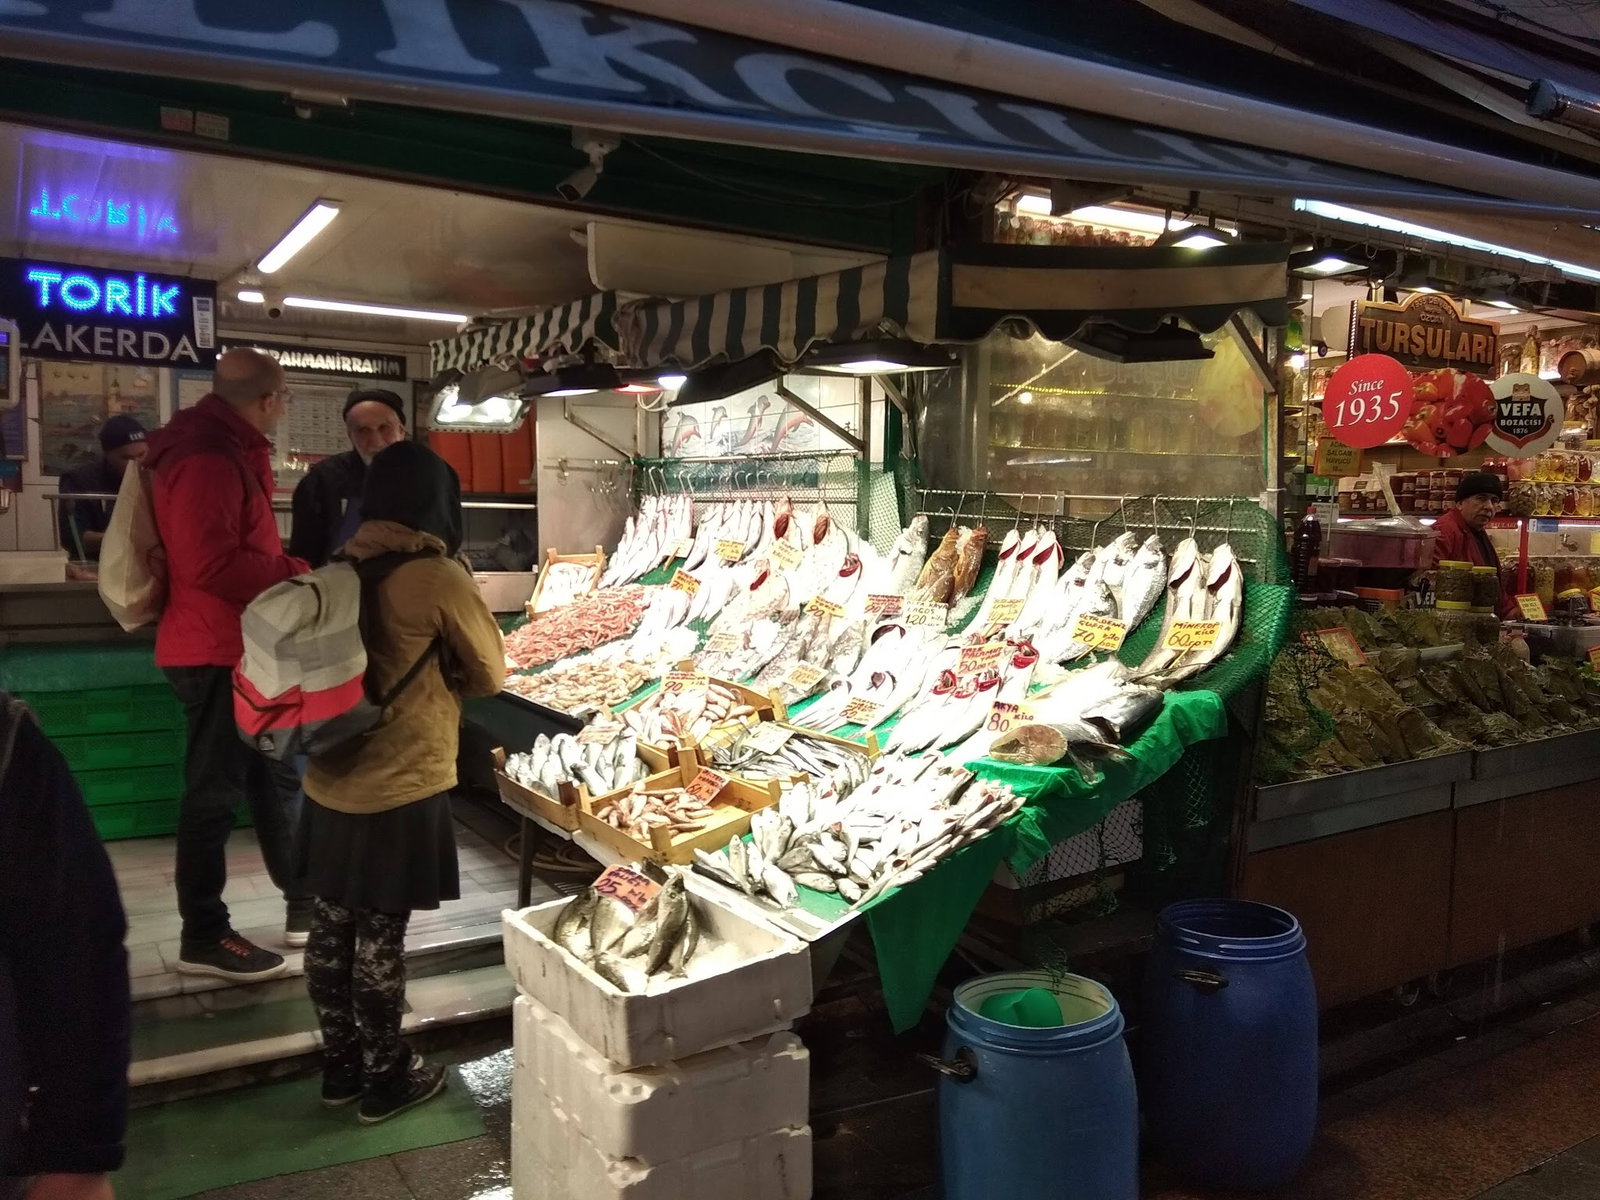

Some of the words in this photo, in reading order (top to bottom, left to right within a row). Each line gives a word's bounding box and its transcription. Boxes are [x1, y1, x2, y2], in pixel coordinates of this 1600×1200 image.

[28, 270, 180, 318] TORİK
[1348, 379, 1385, 396] Since
[1332, 390, 1403, 428] 1935
[1500, 402, 1542, 417] VEFA
[1500, 419, 1542, 427] BOZACISI
[1512, 427, 1529, 435] 1876
[806, 605, 825, 616] 90
[904, 613, 928, 626] 120
[1072, 627, 1096, 643] 70
[1168, 631, 1191, 647] 60
[664, 680, 684, 692] 90
[993, 701, 1020, 713] AKYA
[987, 712, 1010, 732] 80
[594, 878, 622, 894] 25
